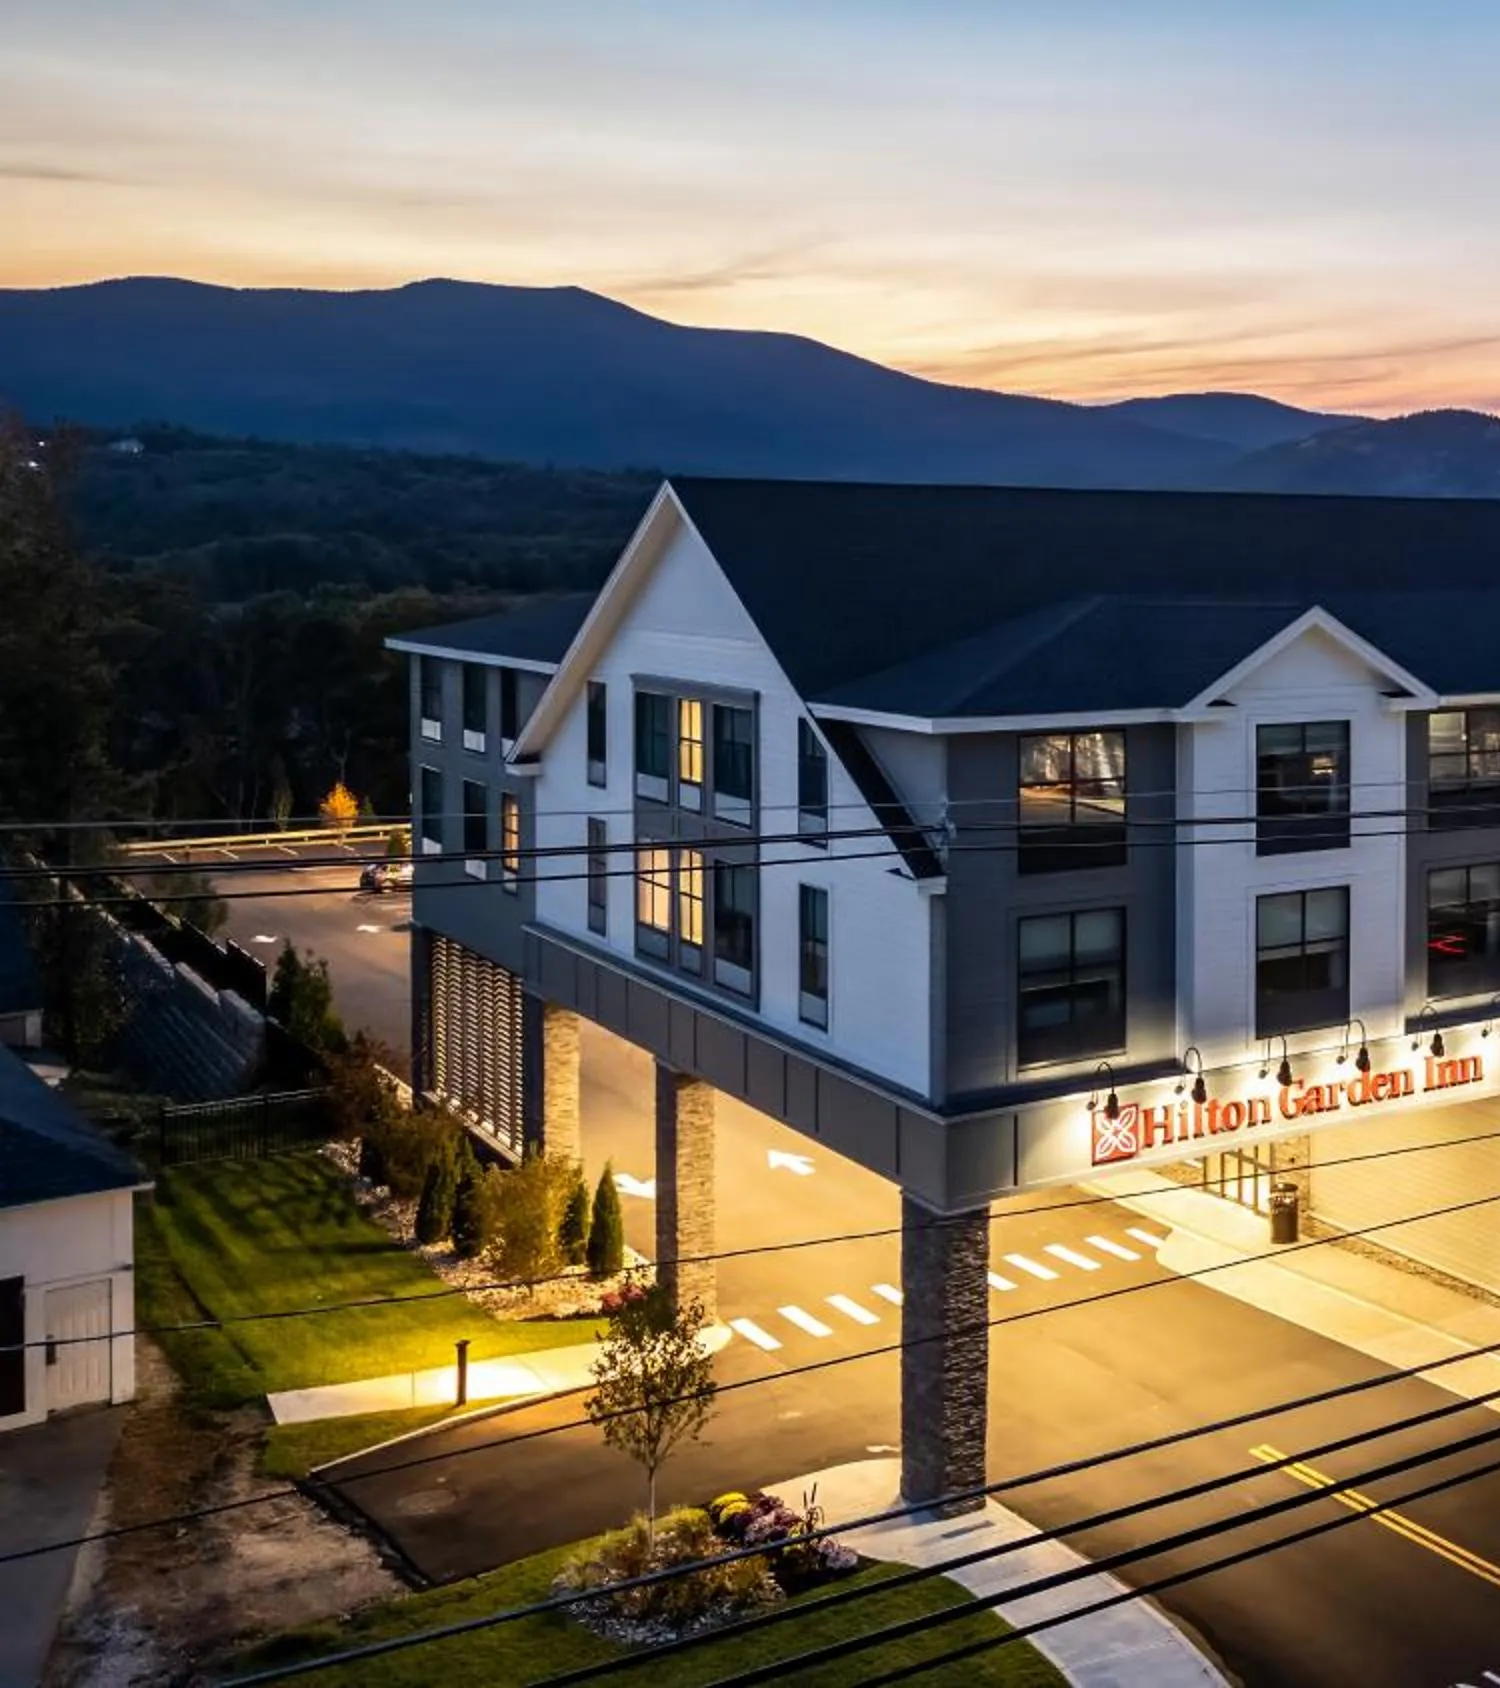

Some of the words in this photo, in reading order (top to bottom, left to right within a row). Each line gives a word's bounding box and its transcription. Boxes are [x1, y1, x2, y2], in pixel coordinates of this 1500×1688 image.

[1142, 1096, 1271, 1148] Hilton
[1279, 1065, 1414, 1119] Garden
[1423, 1055, 1484, 1092] Inn
